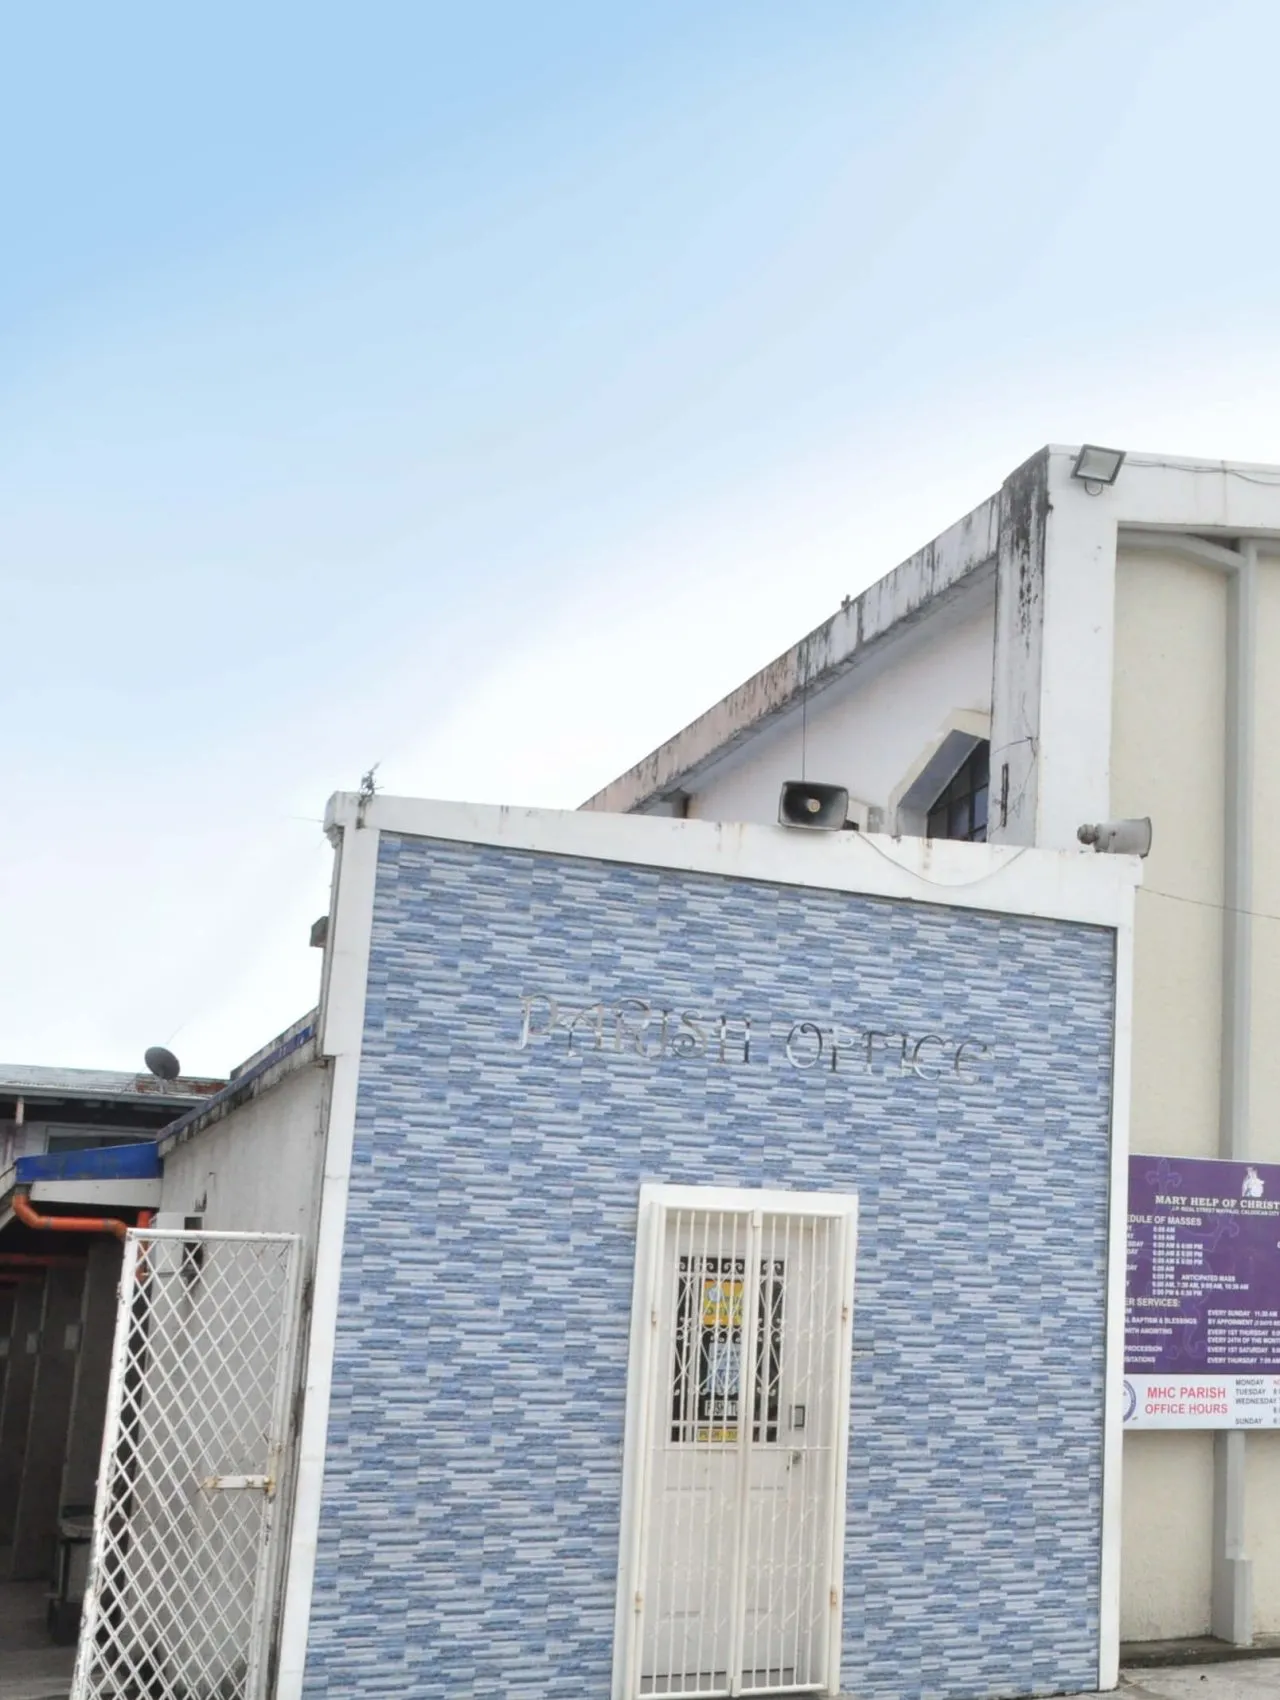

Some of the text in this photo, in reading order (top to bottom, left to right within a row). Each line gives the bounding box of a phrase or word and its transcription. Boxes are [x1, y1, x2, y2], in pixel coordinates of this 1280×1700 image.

[520, 994, 994, 1084] PARISH OFFICE
[1155, 1195, 1188, 1206] MARY
[1190, 1197, 1220, 1208] HELP
[1222, 1198, 1237, 1208] OF
[1154, 1216, 1202, 1226] OF MASSES
[1136, 1298, 1180, 1308] SERVICES:
[1208, 1336, 1226, 1344] EVERY
[1208, 1346, 1226, 1354] EVERY
[1235, 1378, 1264, 1386] MONDAY
[1147, 1386, 1226, 1399] MHC PARISH
[1236, 1388, 1266, 1396] TUESDAY
[1144, 1403, 1228, 1414] OFFICE HOURS
